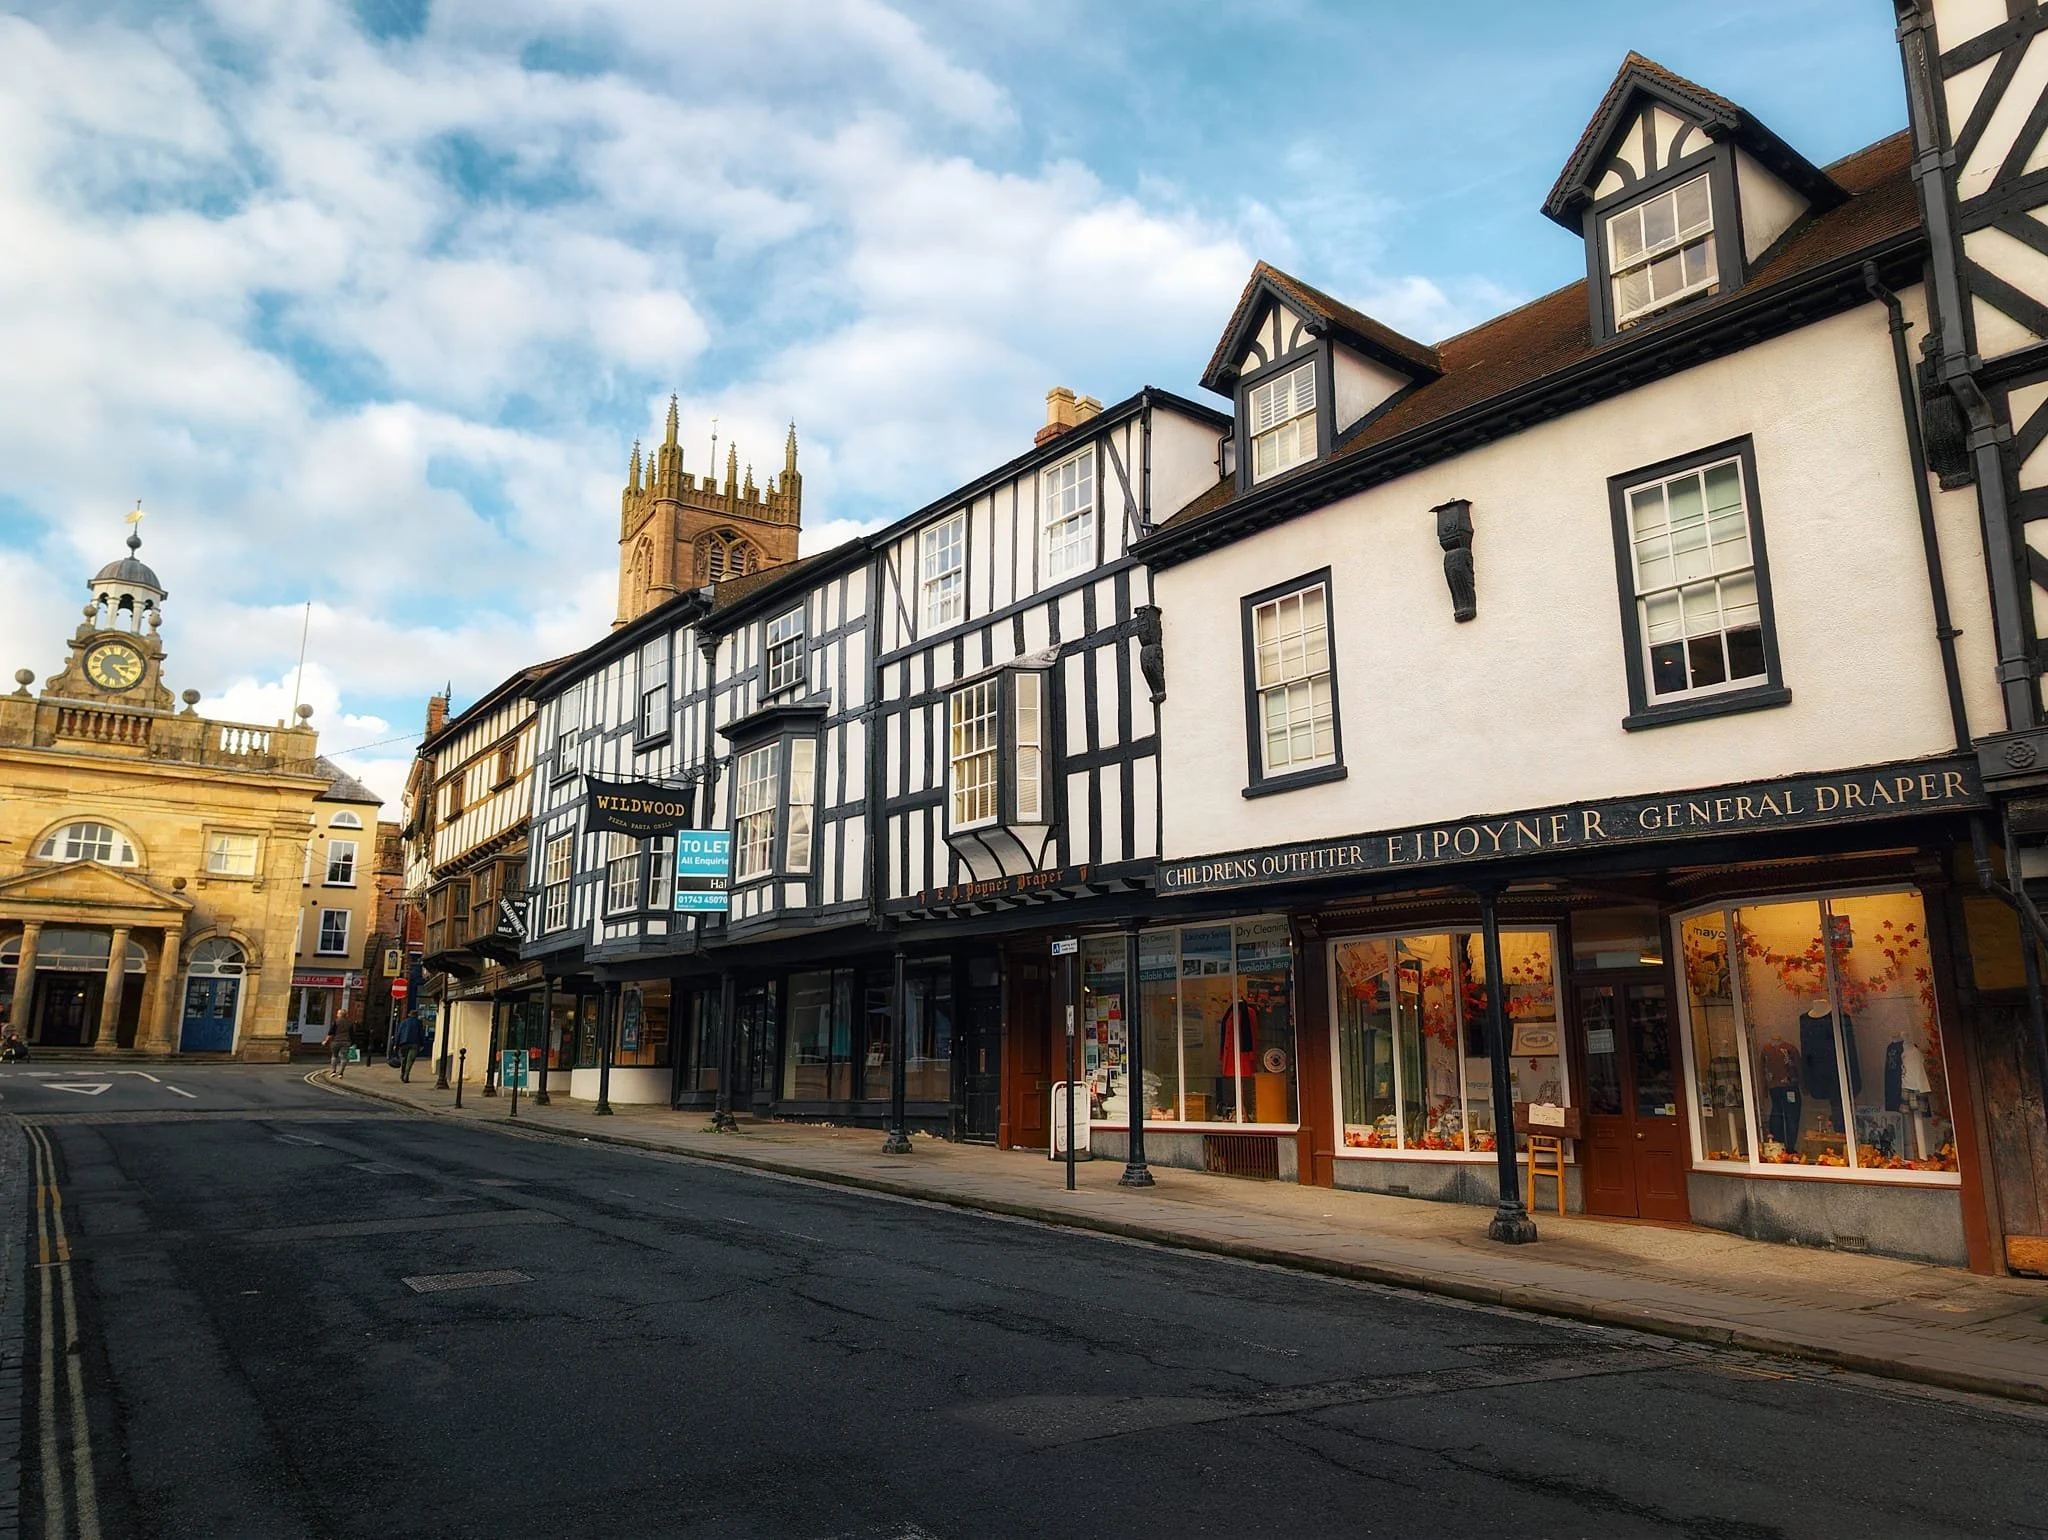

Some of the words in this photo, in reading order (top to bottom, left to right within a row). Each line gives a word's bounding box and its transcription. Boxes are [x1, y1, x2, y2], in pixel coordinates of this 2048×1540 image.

[596, 795, 685, 817] WILDWOOD
[608, 815, 628, 828] PIZZA
[631, 822, 650, 830] PASTA
[653, 821, 673, 830] GRILL
[1166, 859, 1257, 887] CHILDRENS
[1262, 845, 1364, 875] OUTFITTER
[1638, 790, 1804, 830] GENERAL
[1814, 770, 1971, 812] DRAPER
[681, 839, 701, 854] TO
[703, 839, 730, 854] LET
[681, 856, 693, 865] All
[966, 879, 1009, 901] Poyner
[1017, 869, 1064, 893] Draper
[678, 895, 702, 904] 01743
[703, 895, 728, 904] 45070
[1236, 926, 1252, 938] Dry
[1253, 922, 1289, 936] Cleaning
[1237, 961, 1271, 974] Available
[1272, 959, 1289, 969] here
